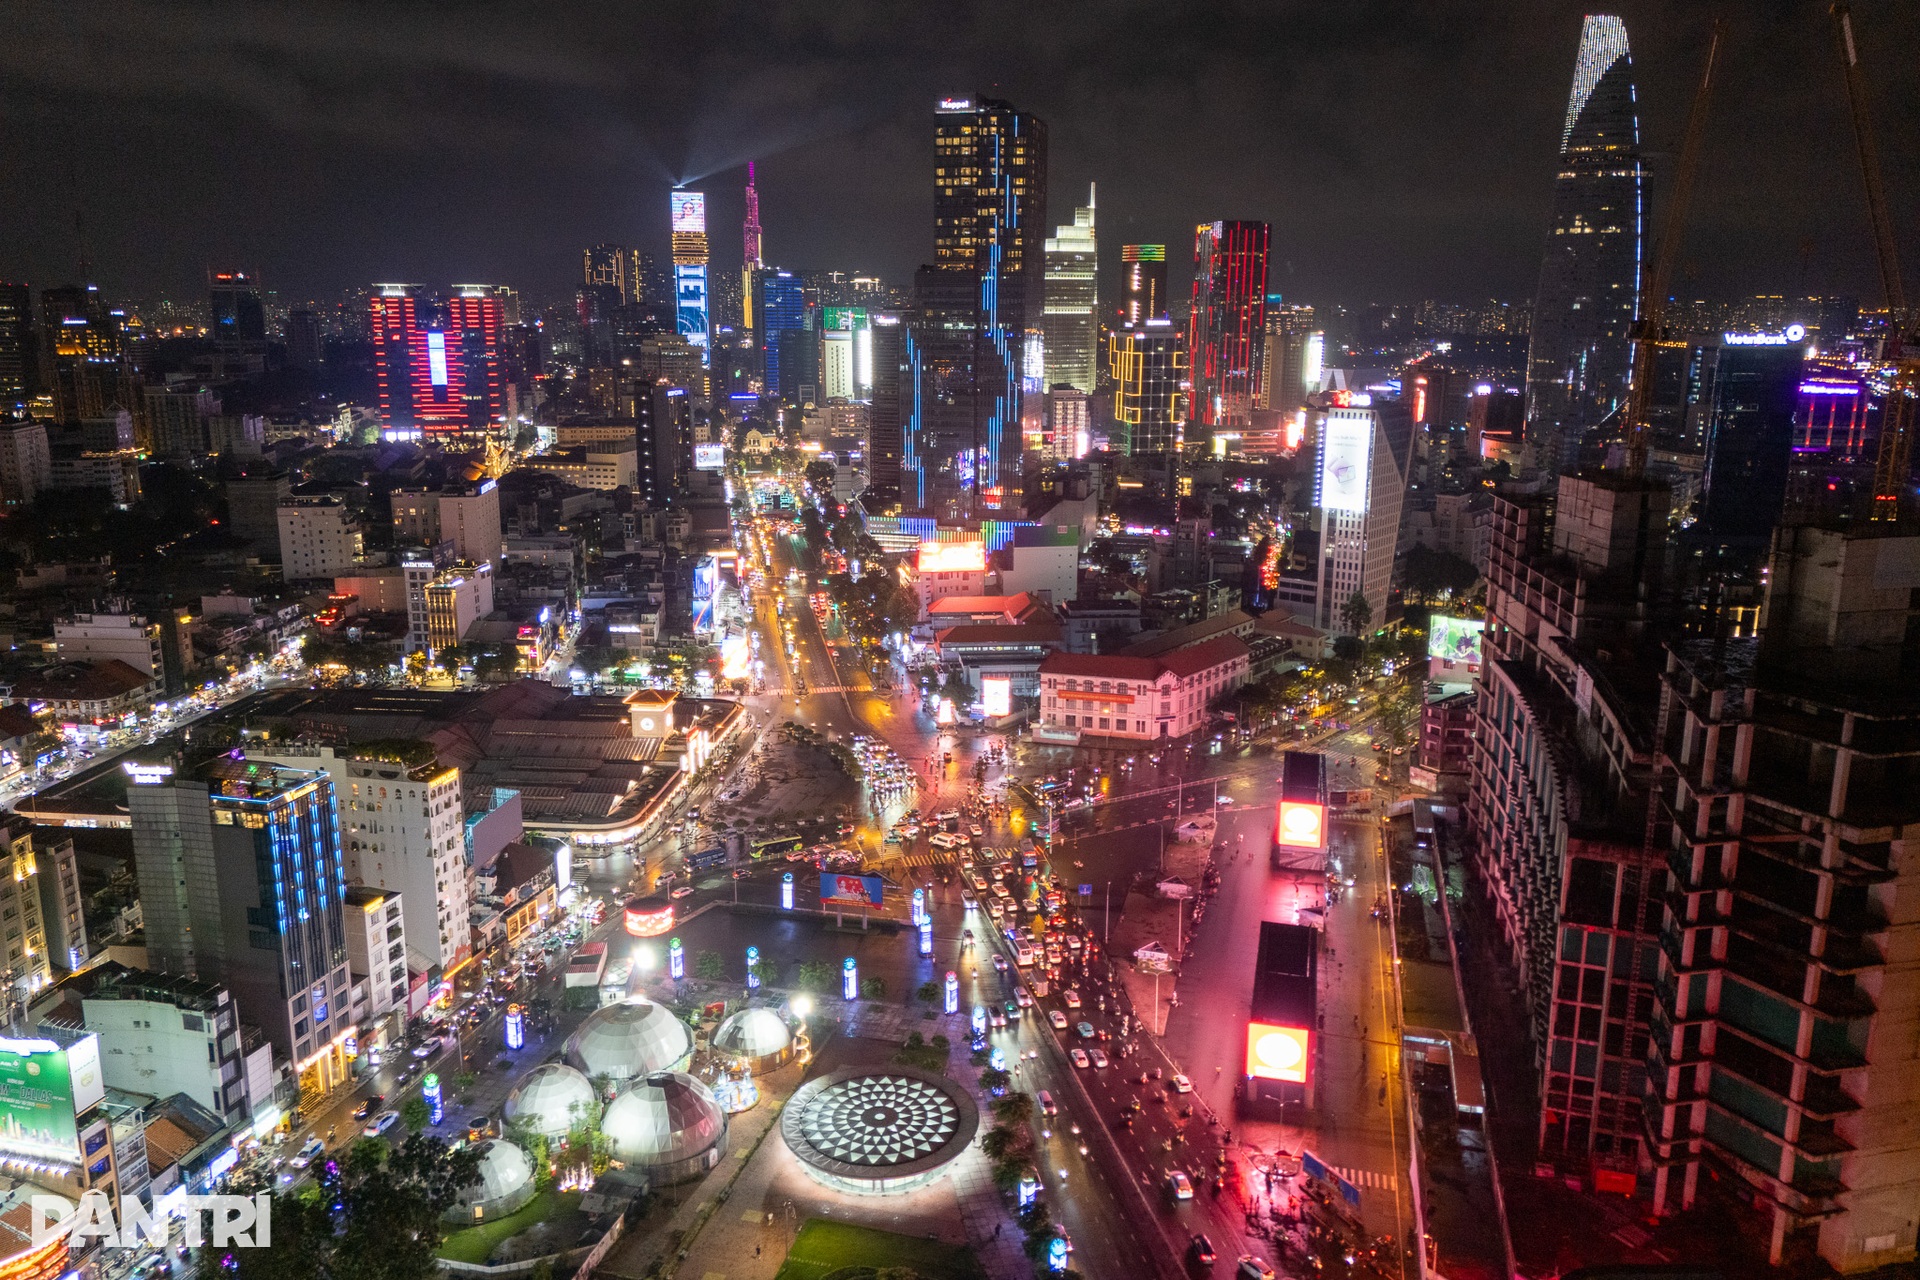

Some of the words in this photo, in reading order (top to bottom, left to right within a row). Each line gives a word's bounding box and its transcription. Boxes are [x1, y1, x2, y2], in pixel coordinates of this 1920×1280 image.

[941, 100, 969, 110] Keppel
[1724, 332, 1787, 345] VietinBank
[19, 1086, 53, 1103] DALLAS
